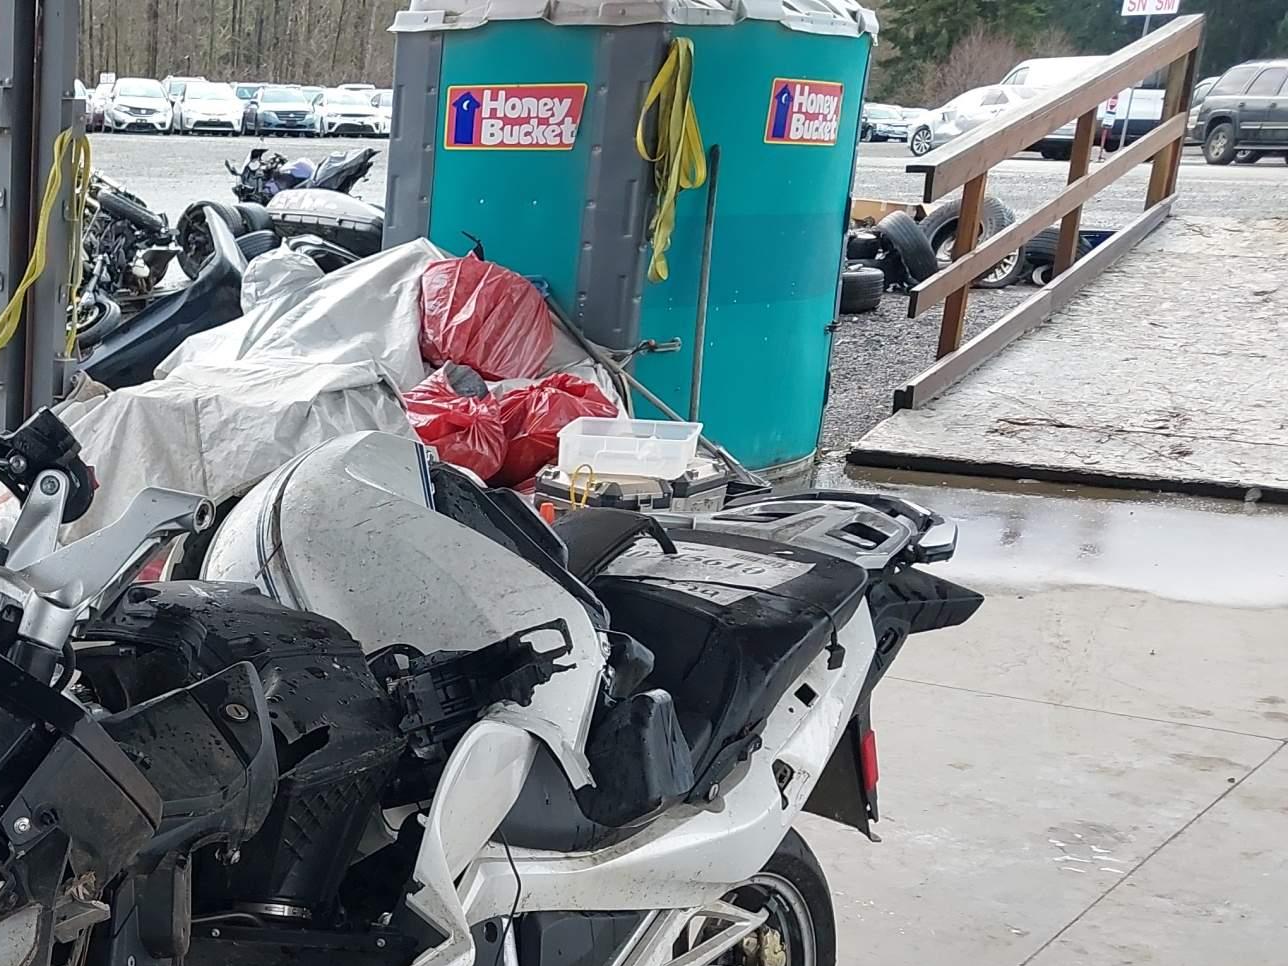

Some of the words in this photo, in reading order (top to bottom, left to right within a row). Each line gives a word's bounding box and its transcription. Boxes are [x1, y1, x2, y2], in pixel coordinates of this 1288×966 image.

[481, 89, 572, 124] Honey
[792, 83, 838, 120] Honey
[480, 117, 578, 145] Bucket
[789, 113, 838, 141] Bucket
